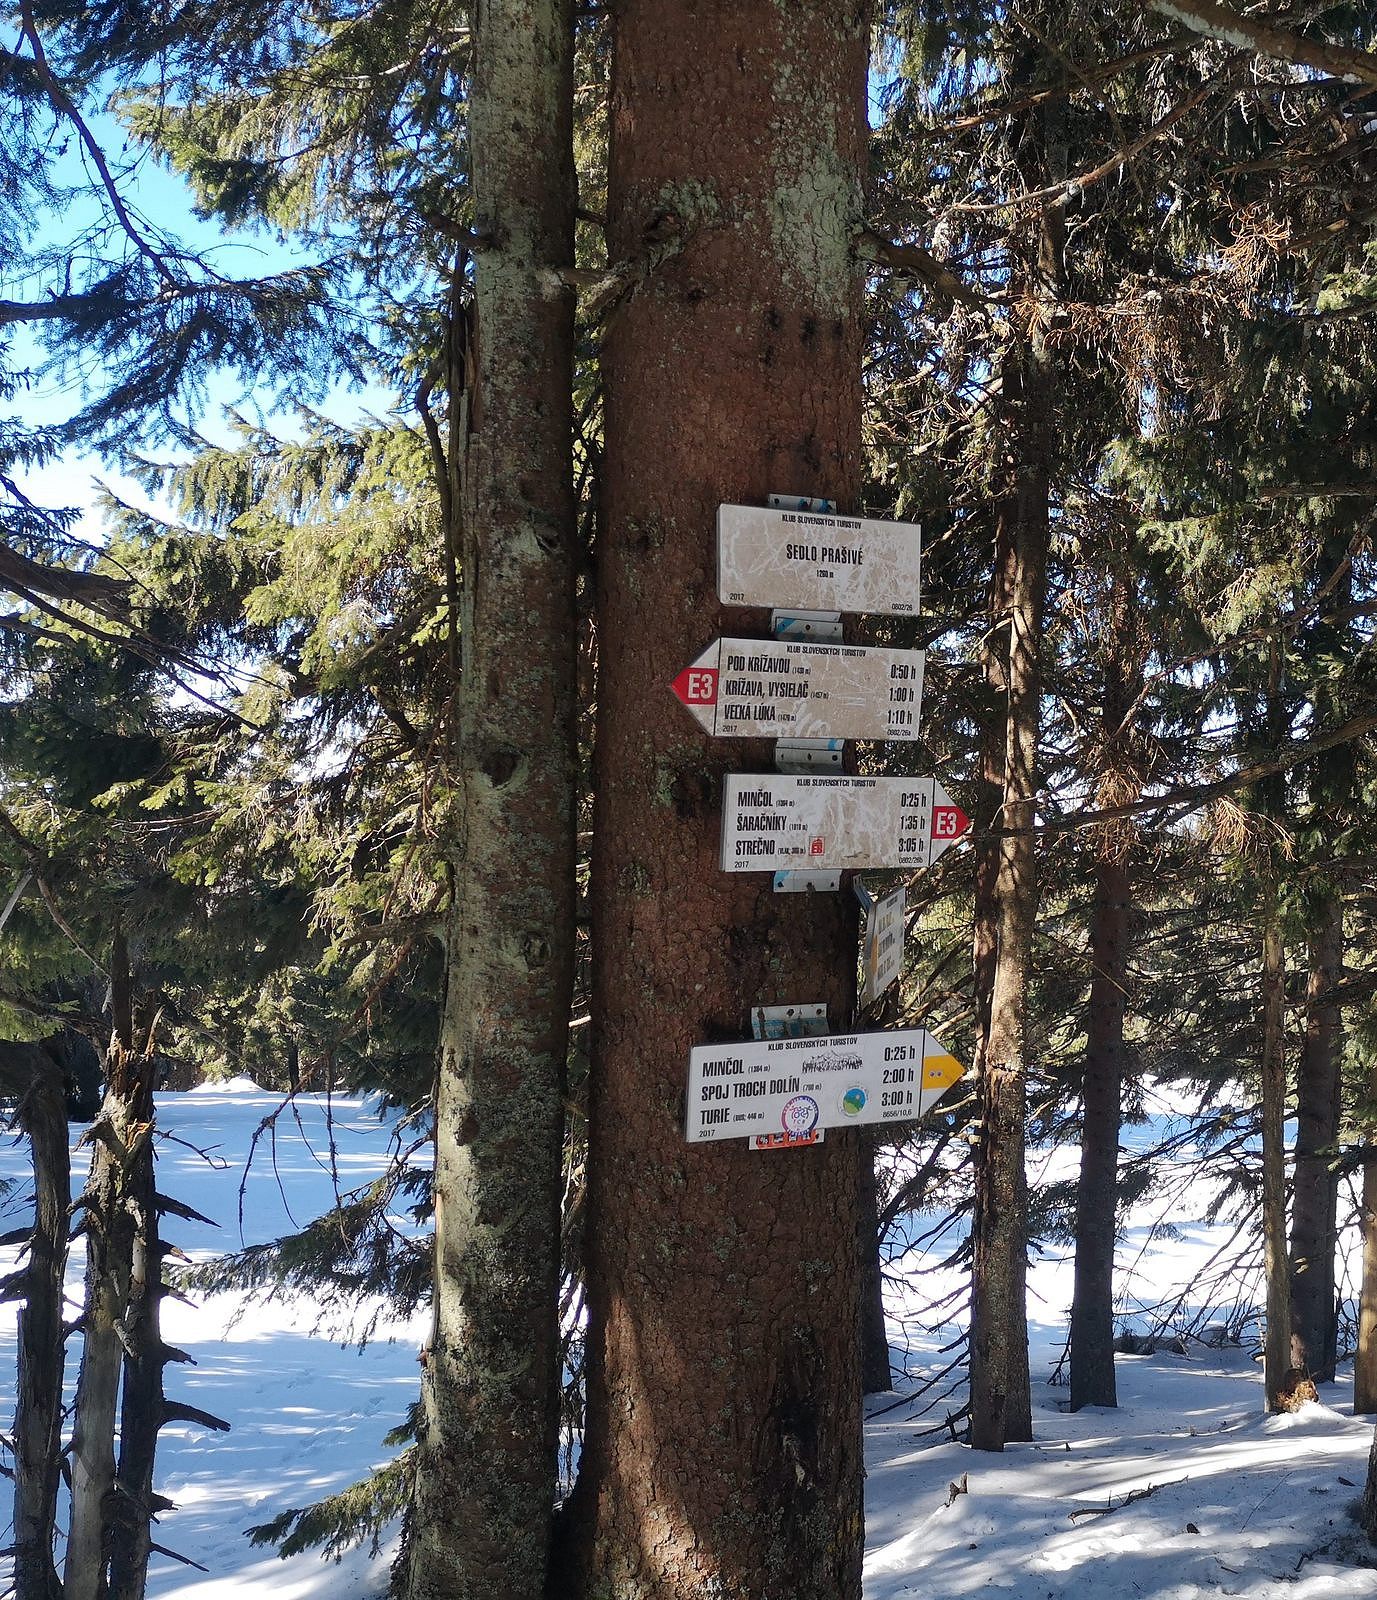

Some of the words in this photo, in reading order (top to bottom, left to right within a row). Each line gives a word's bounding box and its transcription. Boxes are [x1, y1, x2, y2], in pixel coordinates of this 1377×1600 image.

[782, 514, 796, 522] KLUB
[797, 515, 835, 527] SLOVENSKÝCH
[836, 519, 862, 530] TURISTOV
[786, 544, 817, 562] SEDLO
[821, 546, 863, 565] PRAŠIVÉ
[729, 592, 745, 601] 2017
[787, 645, 801, 653] KLUB
[802, 646, 840, 656] SLOVENSKÝCH
[841, 649, 867, 657] TURISTOV
[727, 655, 745, 671] POD
[748, 654, 790, 674] KRÍŽAVOU
[891, 664, 909, 679] 0:50
[911, 665, 916, 679] h
[687, 673, 713, 699] E3
[725, 677, 765, 699] KRÍŽAVA,
[768, 680, 809, 699] VYSIELAČ
[890, 687, 906, 702] 1:00
[909, 688, 914, 702] h
[724, 702, 751, 720] VEĽKÁ
[754, 703, 776, 720] LÚKA
[888, 710, 905, 724] 1:10
[907, 710, 912, 724] h
[812, 778, 849, 787] SLOVENSKÝCH
[851, 779, 876, 787] TURISTOV
[737, 788, 773, 807] MINČOL
[901, 793, 919, 807] 0:25
[921, 793, 927, 807] h
[736, 813, 787, 831] ŠARAČNÍKY
[900, 815, 918, 830] 1:35
[920, 816, 925, 830] h
[936, 812, 957, 835] E3
[735, 837, 776, 856] STREČNO
[898, 838, 916, 853] 3:05
[919, 838, 924, 852] h
[768, 1043, 784, 1052] KLUB
[785, 1039, 828, 1050] SLOVENSKÝCH
[830, 1037, 858, 1046] TURISTOV
[884, 1046, 906, 1061] 0:25
[909, 1045, 915, 1059] h
[702, 1057, 744, 1078] MINČOL
[882, 1068, 905, 1084] 2:00
[908, 1068, 914, 1082] h
[701, 1084, 729, 1101] SPOJ
[733, 1081, 766, 1098] TROCH
[769, 1075, 800, 1095] DOLÍN
[881, 1090, 903, 1106] 3:00
[907, 1090, 913, 1104] h
[700, 1107, 730, 1125] TURIE
[699, 1129, 716, 1138] 2017
